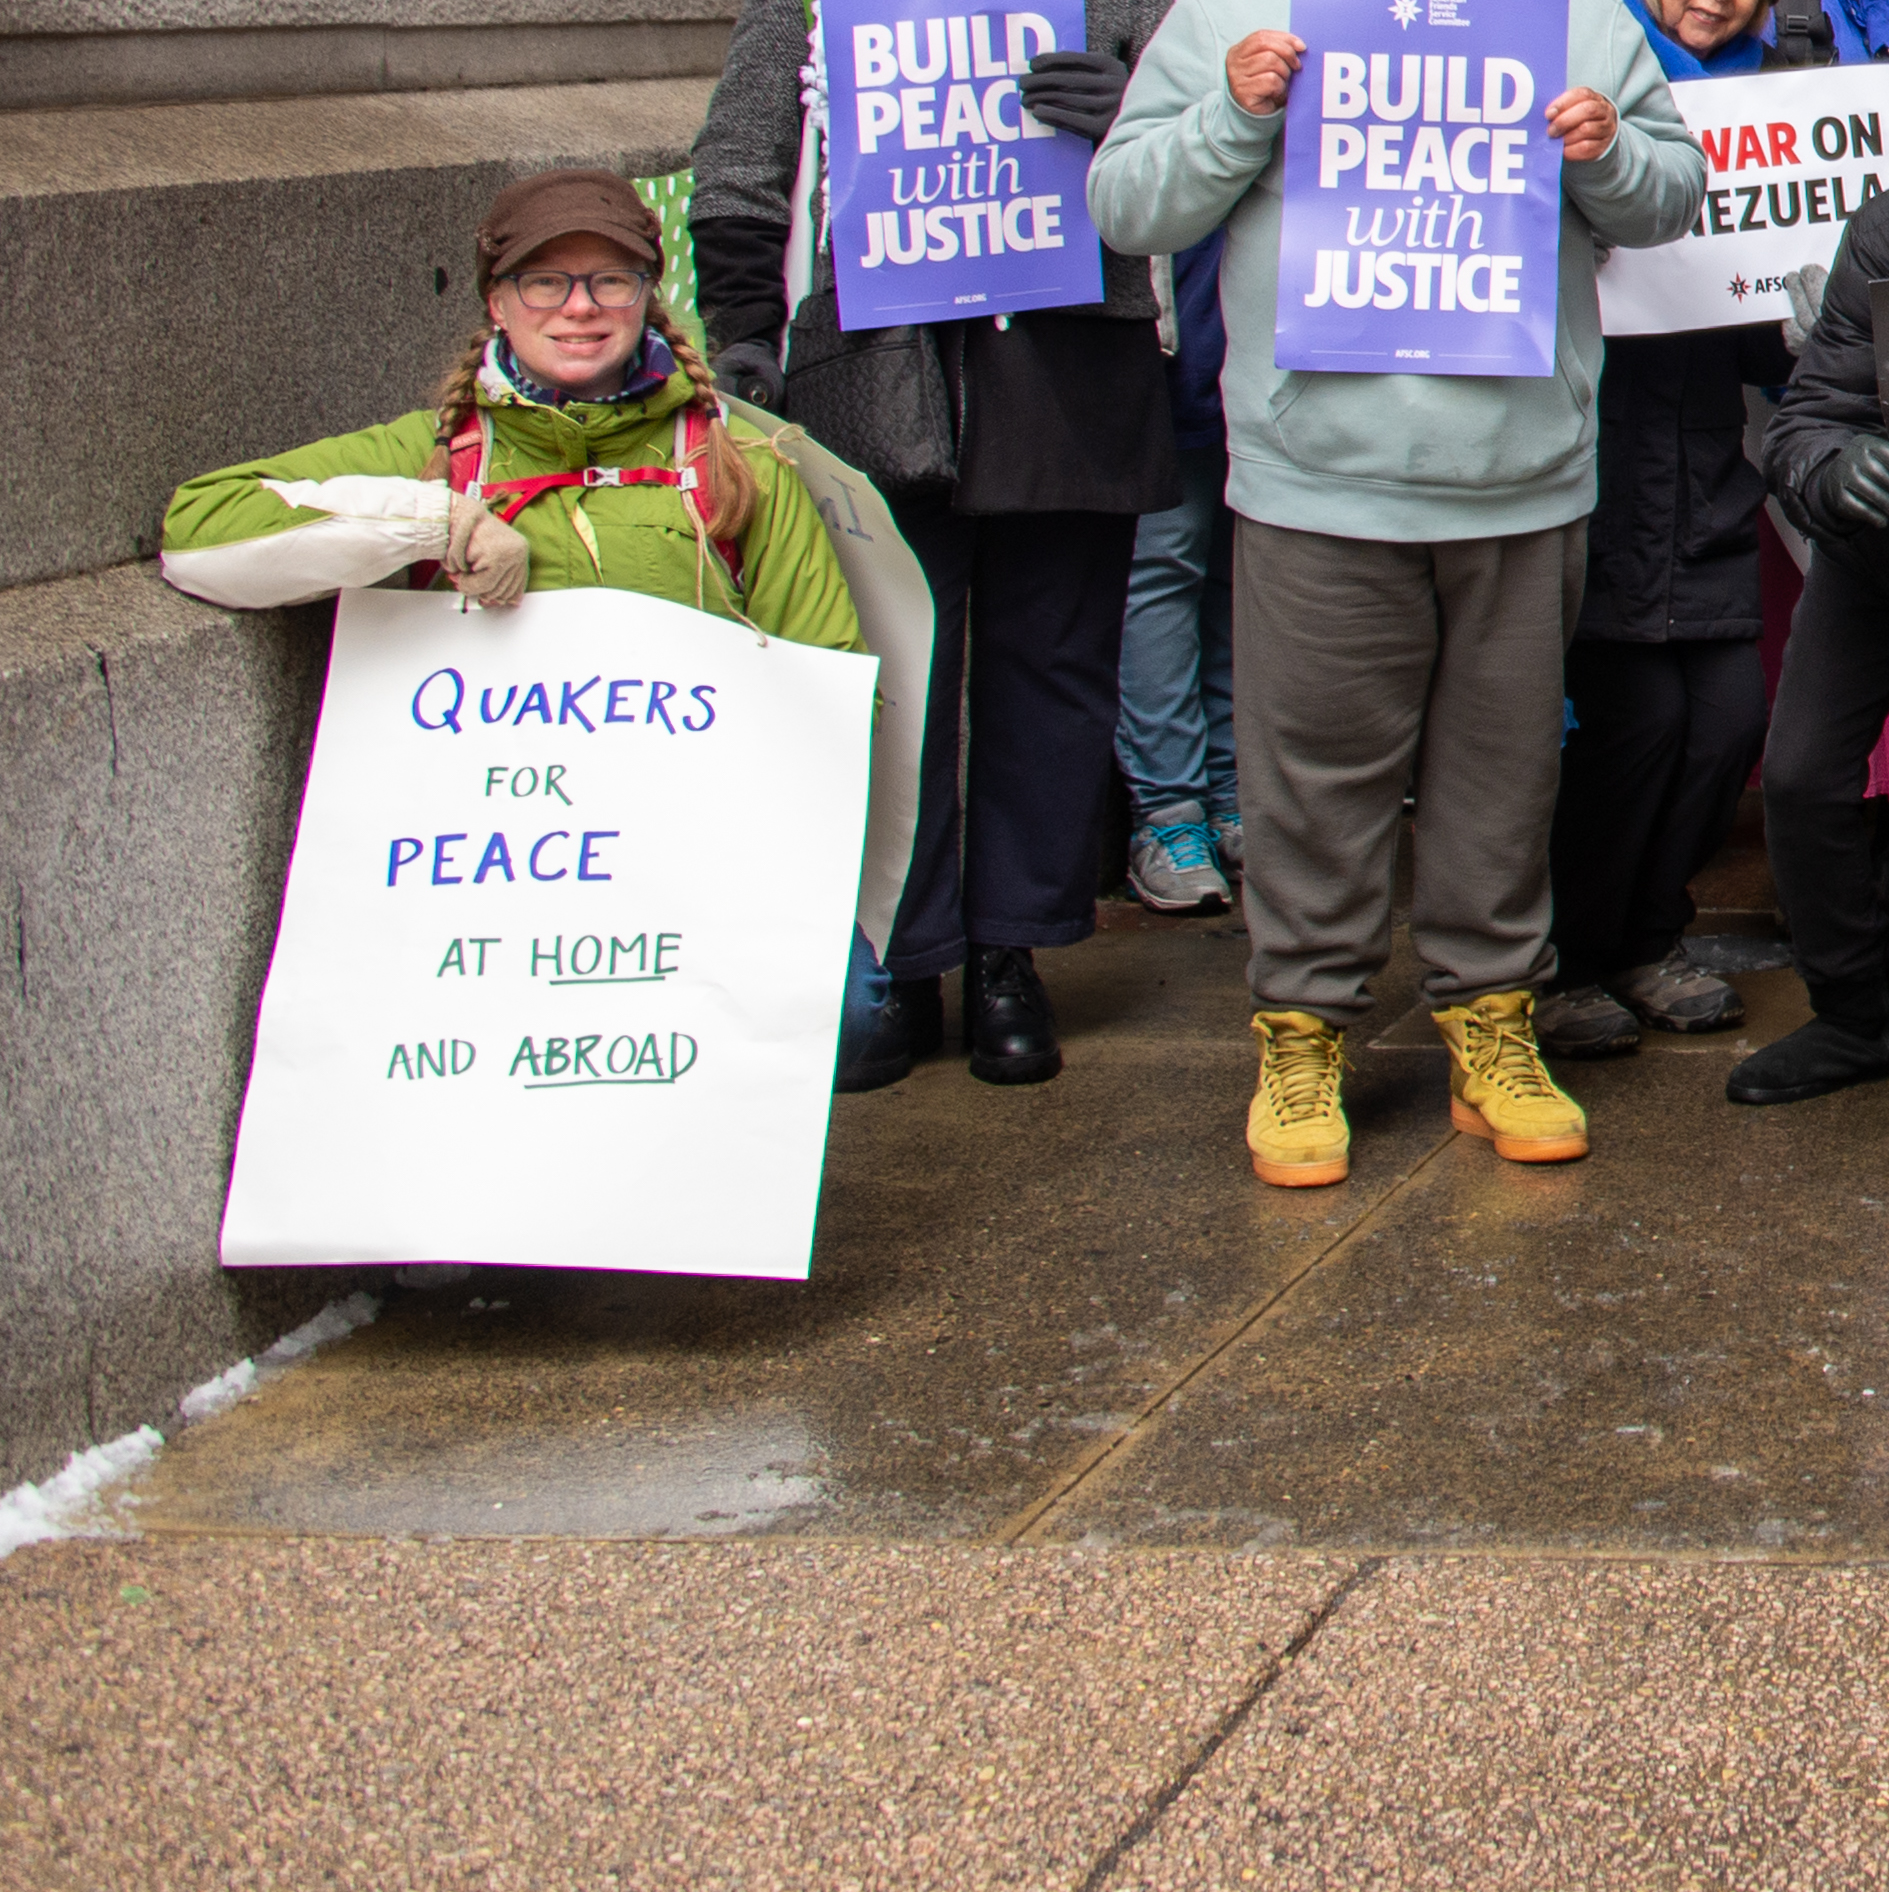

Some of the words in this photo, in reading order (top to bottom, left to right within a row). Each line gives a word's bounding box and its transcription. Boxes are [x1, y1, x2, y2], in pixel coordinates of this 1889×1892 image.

[852, 12, 1057, 88] BUILD
[1322, 51, 1535, 124] BUILD
[1320, 123, 1528, 194] PEACE
[1811, 112, 1884, 161] ON
[888, 144, 1023, 206] with
[860, 194, 1065, 268] JUSTICE
[1346, 194, 1484, 249] with
[954, 294, 987, 305] AFSC.ORG
[1304, 250, 1522, 313] JUSTICE
[1395, 349, 1430, 359] AFSC.ORG
[411, 667, 717, 735] QUAKERS
[485, 764, 573, 806] FOR
[387, 830, 621, 887] PEACE
[436, 937, 503, 978] AT
[531, 932, 682, 978] HOME
[387, 1038, 477, 1080] AND
[508, 1031, 699, 1081] ABROAD
